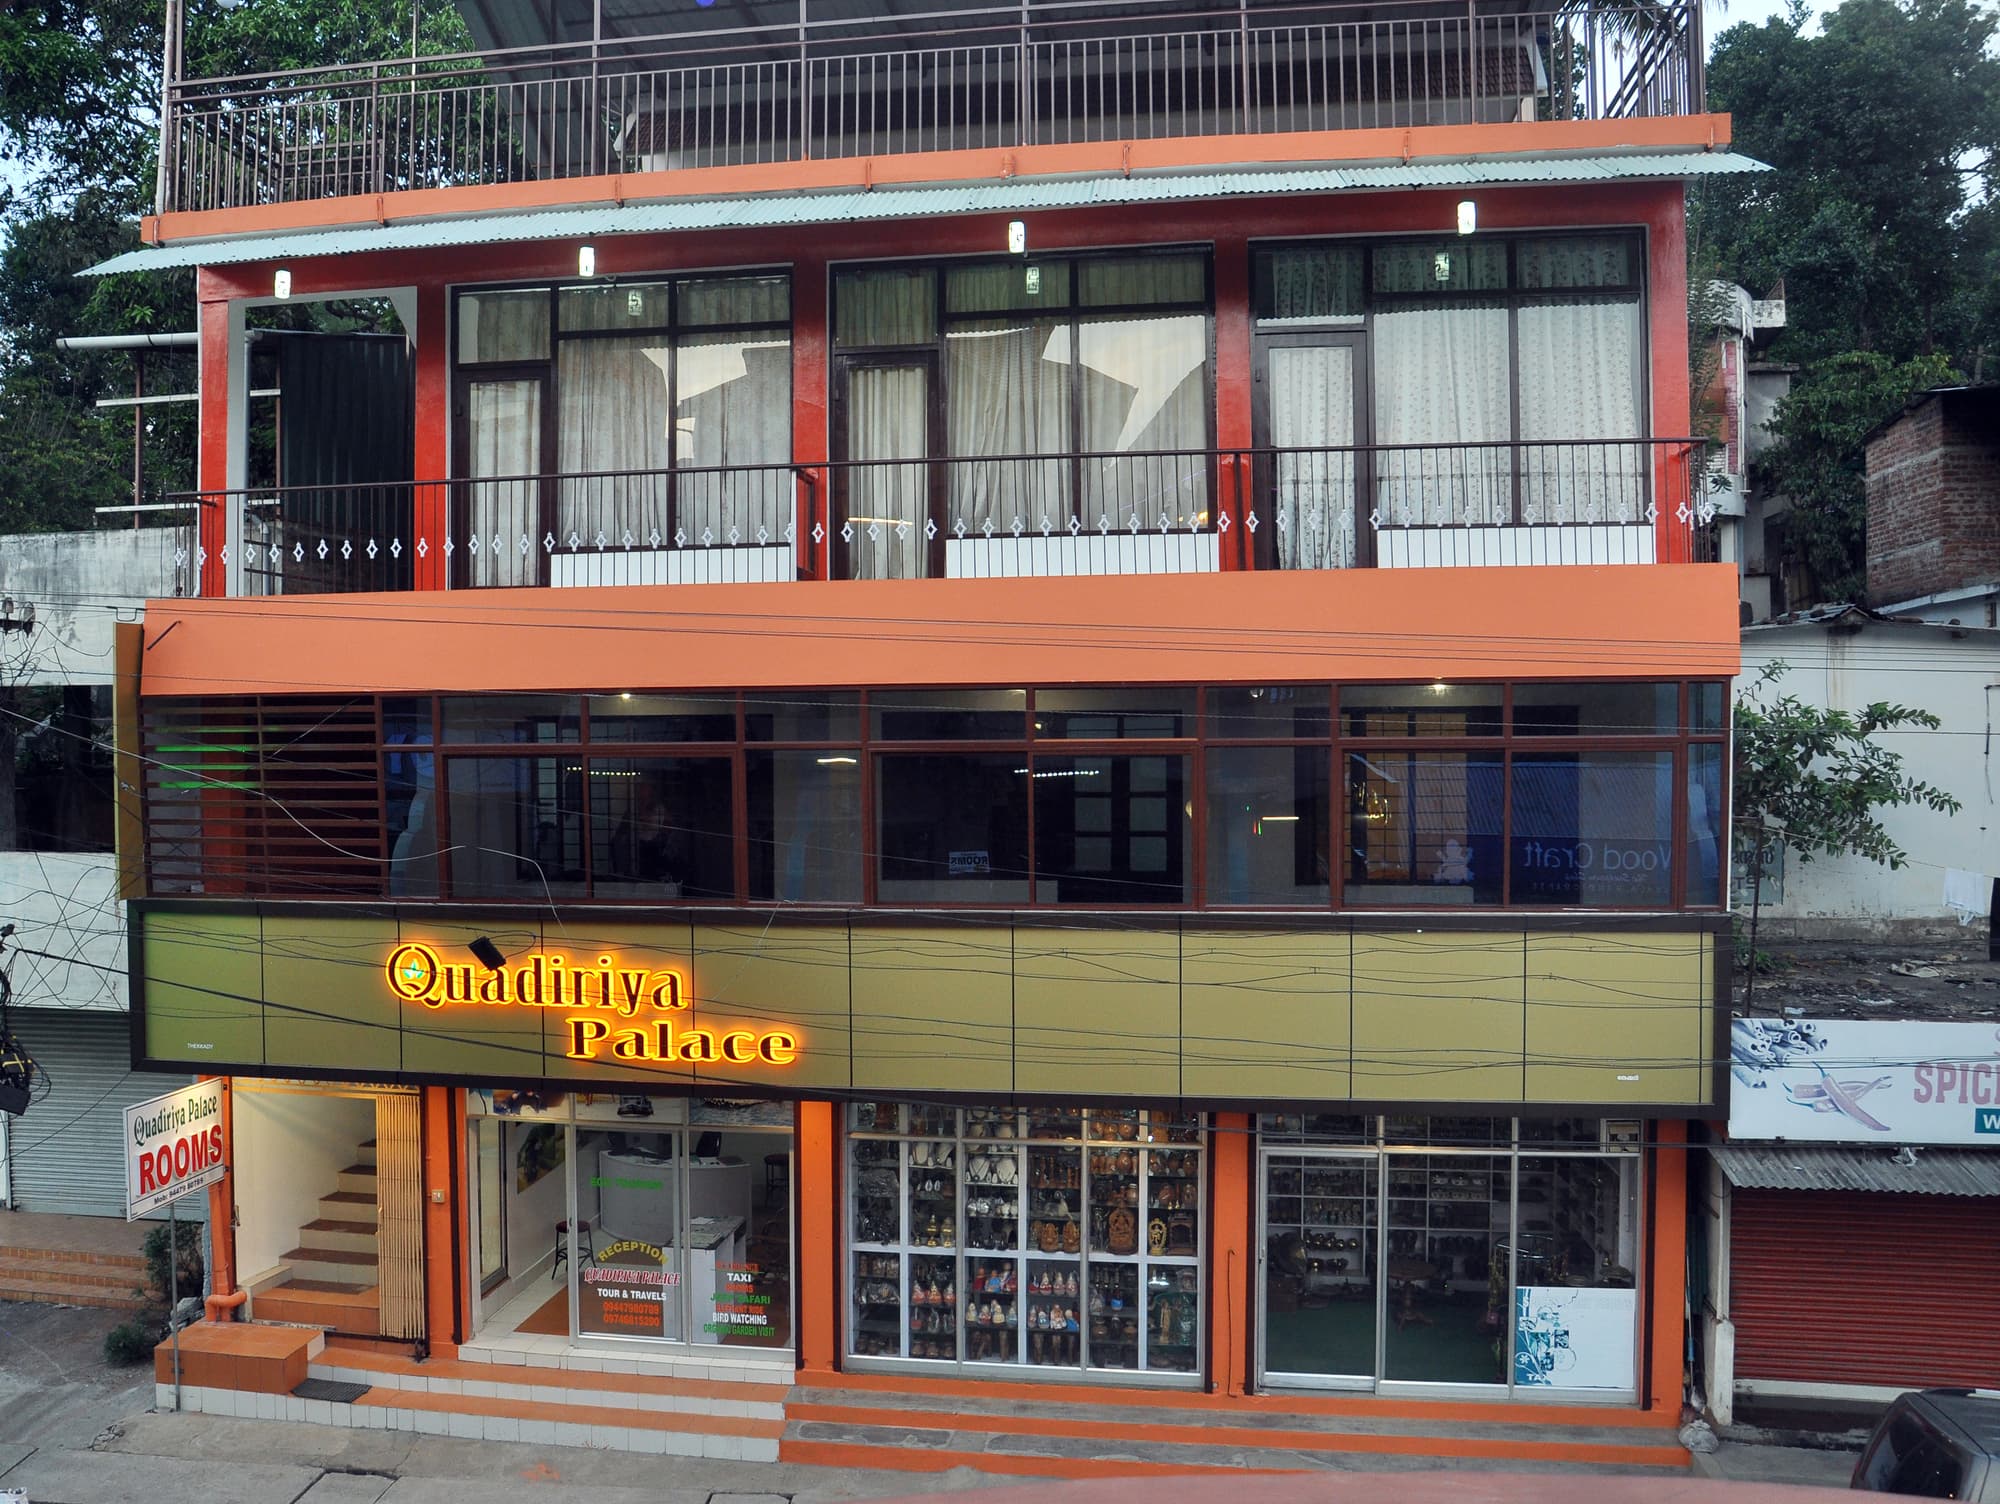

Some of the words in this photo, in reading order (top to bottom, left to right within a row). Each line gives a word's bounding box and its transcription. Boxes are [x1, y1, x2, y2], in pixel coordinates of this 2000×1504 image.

[385, 942, 688, 1017] Quadiriya
[565, 1017, 797, 1064] Palace
[134, 1105, 186, 1147] Quadiriya
[188, 1095, 217, 1123] Palace
[139, 1124, 223, 1195] ROOMS
[598, 1241, 669, 1265] RECEPTION
[584, 1266, 640, 1284] QUADIRIYA
[641, 1270, 681, 1287] PALACE
[727, 1272, 752, 1283] TAXI
[597, 1288, 620, 1298] TOUR
[622, 1289, 628, 1299] &
[630, 1290, 667, 1301] TRAVELS
[712, 1312, 728, 1322] BIRD
[730, 1313, 767, 1325] WATCHING
[732, 1325, 757, 1336] GARDEN
[759, 1326, 775, 1337] VISIT
